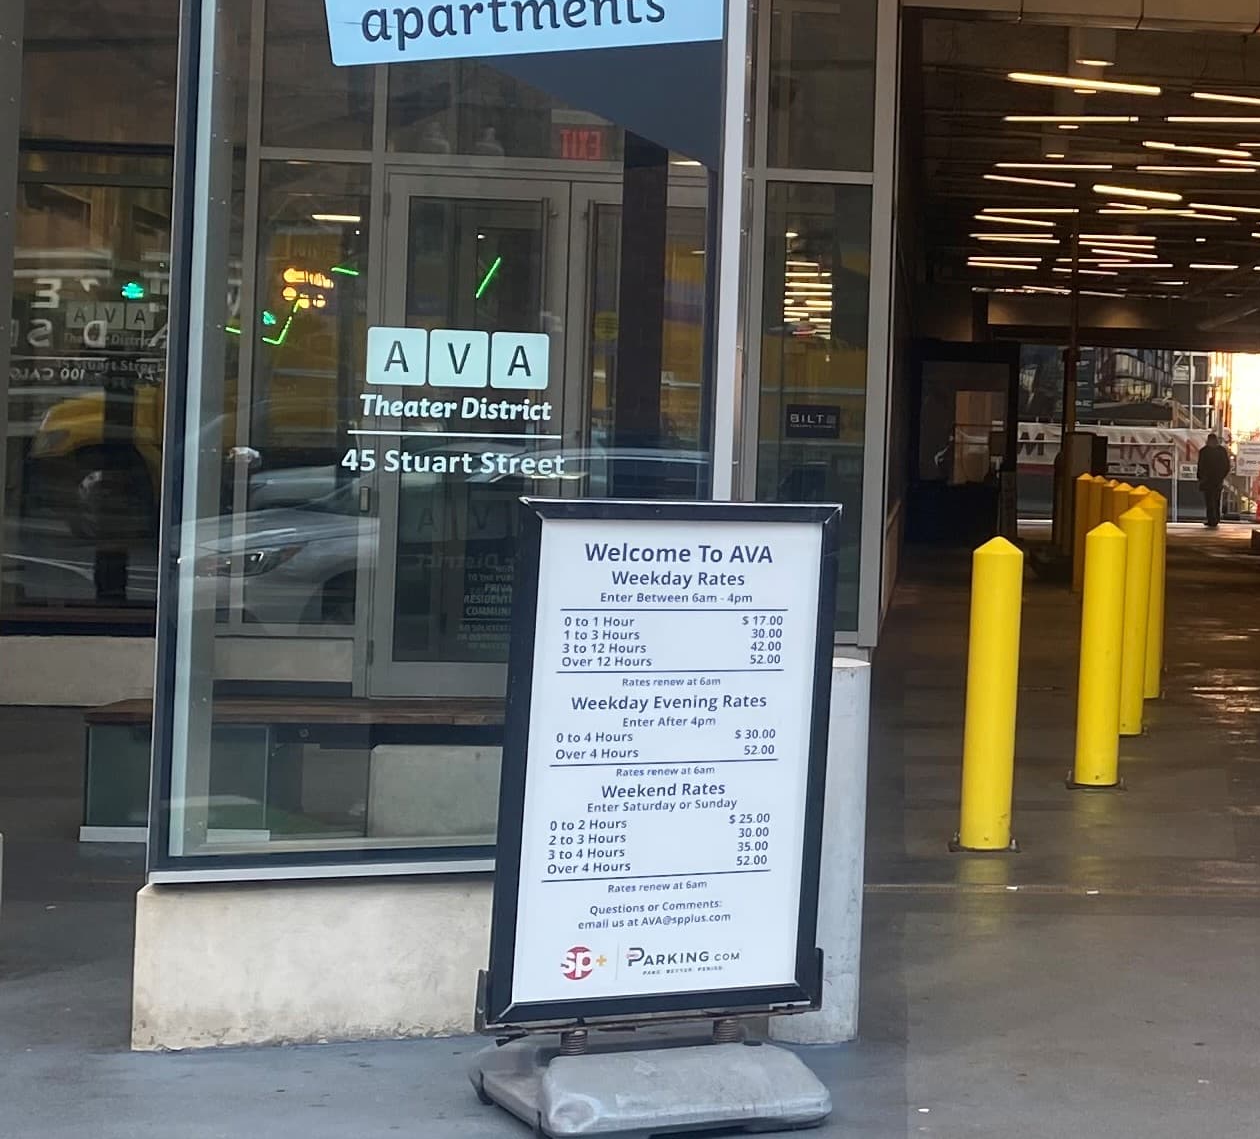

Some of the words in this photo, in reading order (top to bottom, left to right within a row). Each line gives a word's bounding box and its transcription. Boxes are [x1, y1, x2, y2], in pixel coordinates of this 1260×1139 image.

[384, 340, 531, 377] AVA
[359, 394, 457, 418] Theater
[461, 398, 552, 421] District
[341, 449, 376, 472] 45
[384, 450, 472, 473] Stuart
[480, 452, 565, 475] Street
[585, 542, 691, 563] Welcome
[698, 544, 723, 563] To
[729, 545, 773, 564] AVA
[611, 570, 693, 590] Weekday
[698, 571, 745, 586] Rates
[600, 592, 634, 603] Enter
[636, 592, 689, 603] Between
[691, 592, 718, 603] 6am
[727, 593, 753, 605] 4pm
[564, 616, 572, 627] 0
[575, 617, 589, 627] to
[593, 616, 599, 627] 1
[603, 616, 635, 627] Hour
[742, 615, 750, 626] $
[752, 615, 784, 626] 17.00
[563, 629, 570, 641] 1
[574, 630, 588, 641] to
[591, 629, 599, 641] 3
[602, 630, 640, 641] Hours
[751, 628, 783, 639] 30.00
[562, 643, 570, 654] 3
[573, 644, 587, 654] to
[591, 642, 605, 654] 12
[608, 642, 647, 654] Hours
[750, 641, 782, 652] 42.00
[561, 656, 593, 667] Over
[597, 656, 611, 667] 12
[614, 656, 652, 667] Hours
[750, 654, 781, 665] 52.00
[622, 678, 651, 687] Rates
[653, 679, 685, 687] renew
[686, 678, 697, 686] at
[699, 676, 721, 686] 6am
[571, 695, 649, 714] Weekday
[653, 695, 718, 712] Evening
[722, 694, 767, 708] Rates
[622, 717, 655, 728] Enter
[657, 716, 688, 727] After
[690, 716, 716, 729] 4pm
[556, 732, 564, 744] 0
[567, 733, 581, 743] to
[583, 731, 592, 743] 4
[595, 731, 633, 743] Hours
[734, 729, 742, 740] $
[744, 728, 776, 740] 30.00
[555, 748, 587, 760] Over
[589, 748, 597, 759] 4
[601, 748, 639, 759] Hours
[743, 744, 775, 756] 52.00
[615, 768, 645, 777] Rates
[646, 768, 679, 776] renew
[680, 767, 691, 776] at
[693, 766, 715, 775] 6am
[601, 783, 677, 799] Weekend
[681, 783, 726, 796] Rates
[587, 802, 620, 813] Enter
[622, 800, 677, 813] Saturday
[679, 801, 692, 810] or
[694, 797, 738, 811] Sunday
[549, 820, 558, 832] 0
[561, 821, 575, 831] to
[577, 819, 586, 830] 2
[589, 819, 627, 830] Hours
[729, 814, 736, 825] $
[738, 812, 771, 824] 25.00
[548, 835, 557, 846] 2
[560, 836, 574, 846] to
[576, 834, 585, 845] 3
[588, 833, 627, 844] Hours
[738, 826, 770, 839] 30.00
[548, 849, 556, 861] 3
[558, 850, 573, 860] to
[575, 848, 584, 859] 4
[587, 848, 625, 859] Hours
[737, 840, 769, 852] 35.00
[547, 863, 579, 875] Over
[581, 862, 590, 873] 4
[593, 862, 631, 873] Hours
[736, 854, 768, 867] 52.00
[607, 884, 636, 893] Rates
[638, 883, 671, 892] renew
[672, 881, 683, 890] at
[685, 880, 708, 890] 6am
[589, 904, 645, 917] Questions
[647, 904, 660, 912] or
[662, 900, 724, 911] Comments:
[577, 918, 609, 930] email
[611, 919, 625, 928] us
[627, 918, 639, 927] at
